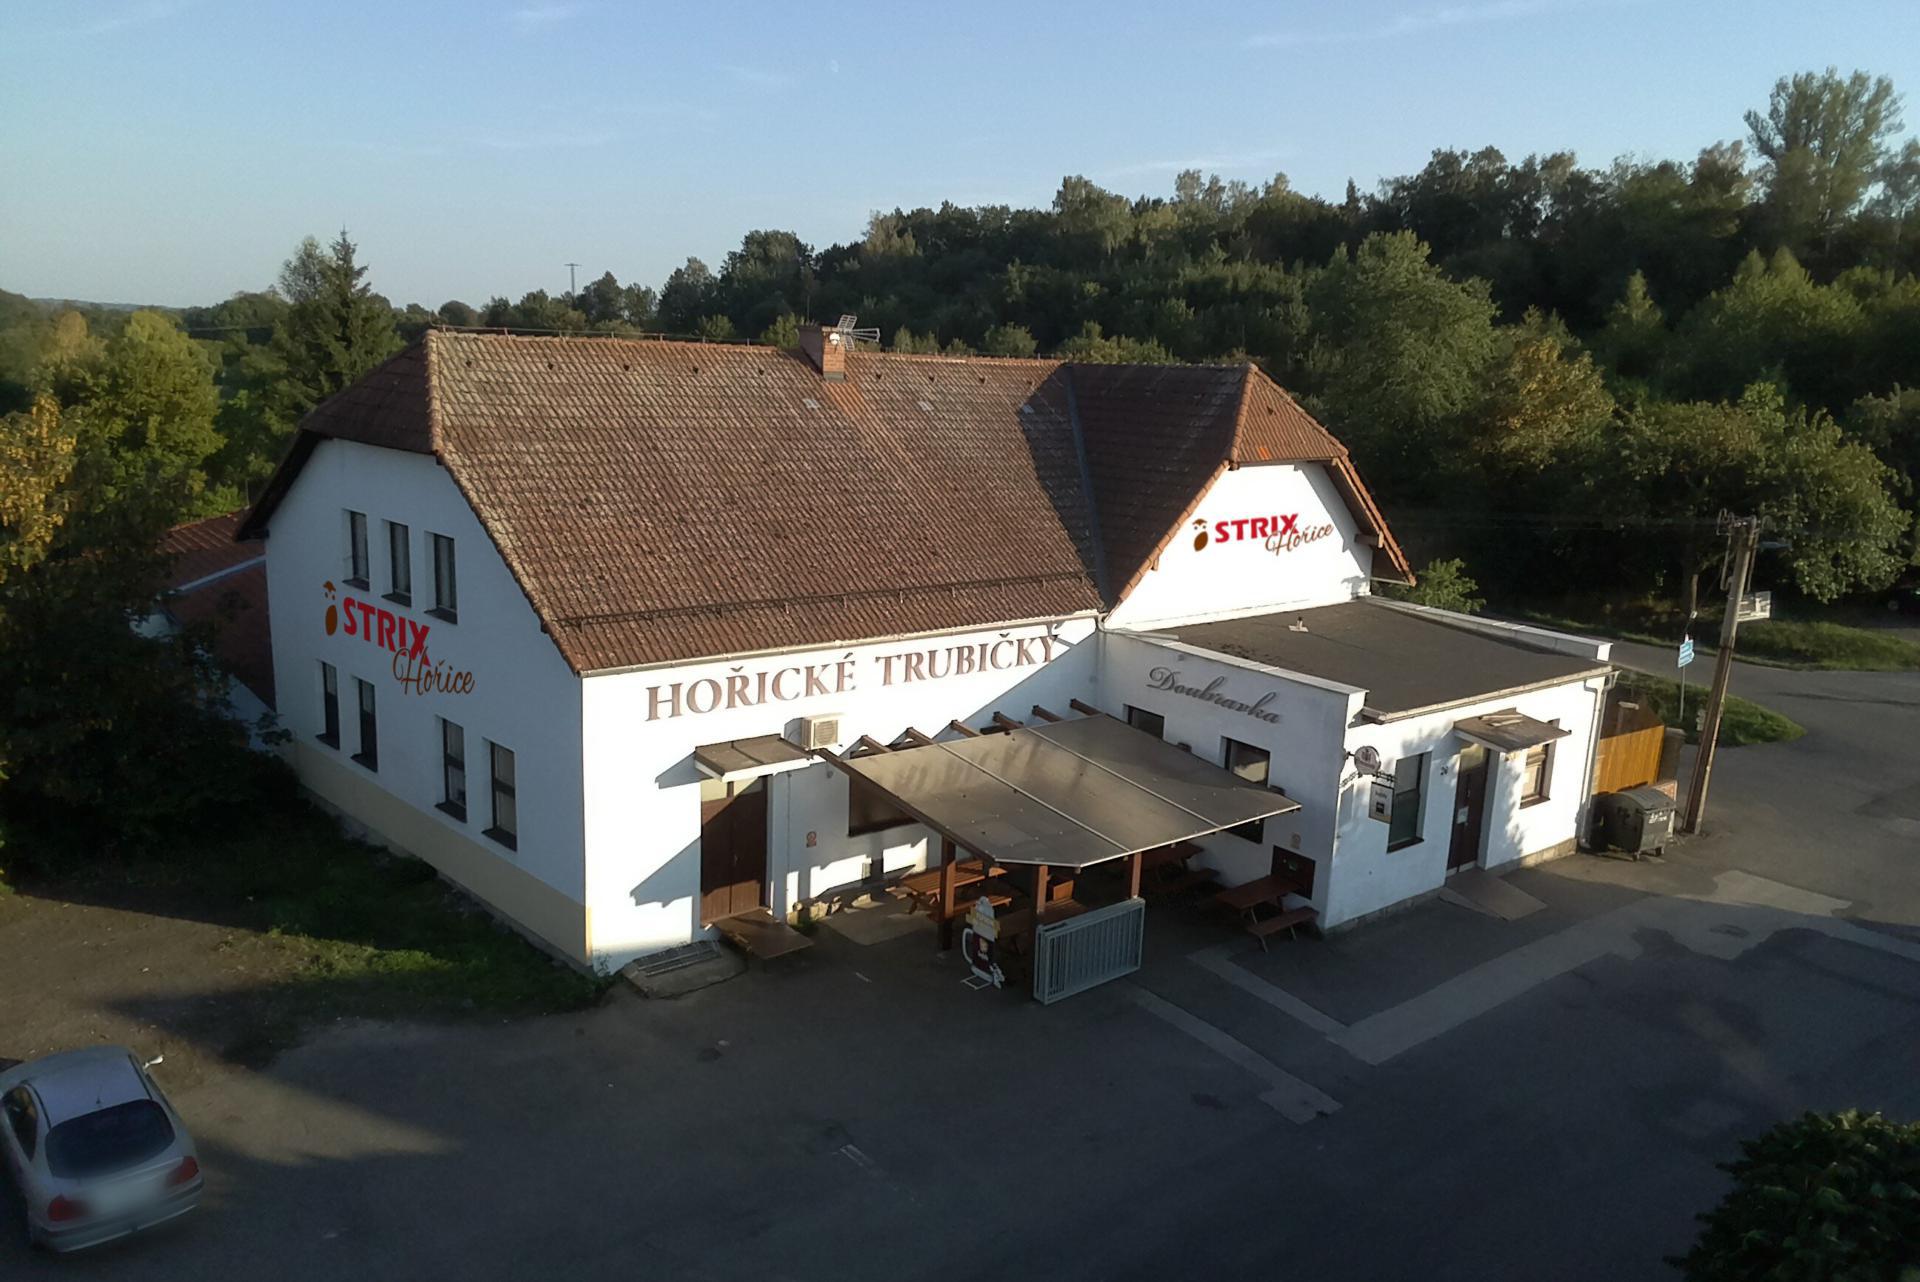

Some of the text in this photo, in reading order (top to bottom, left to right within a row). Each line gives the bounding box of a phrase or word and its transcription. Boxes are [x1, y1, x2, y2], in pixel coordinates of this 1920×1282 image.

[1215, 513, 1299, 543] STRIX
[1265, 523, 1334, 556] Hořice
[343, 597, 431, 667] STRIX
[393, 646, 475, 696] Hořice
[645, 633, 1059, 722] HOŘICKÉ TRUBIČKY
[1146, 666, 1280, 724] Doubravka
